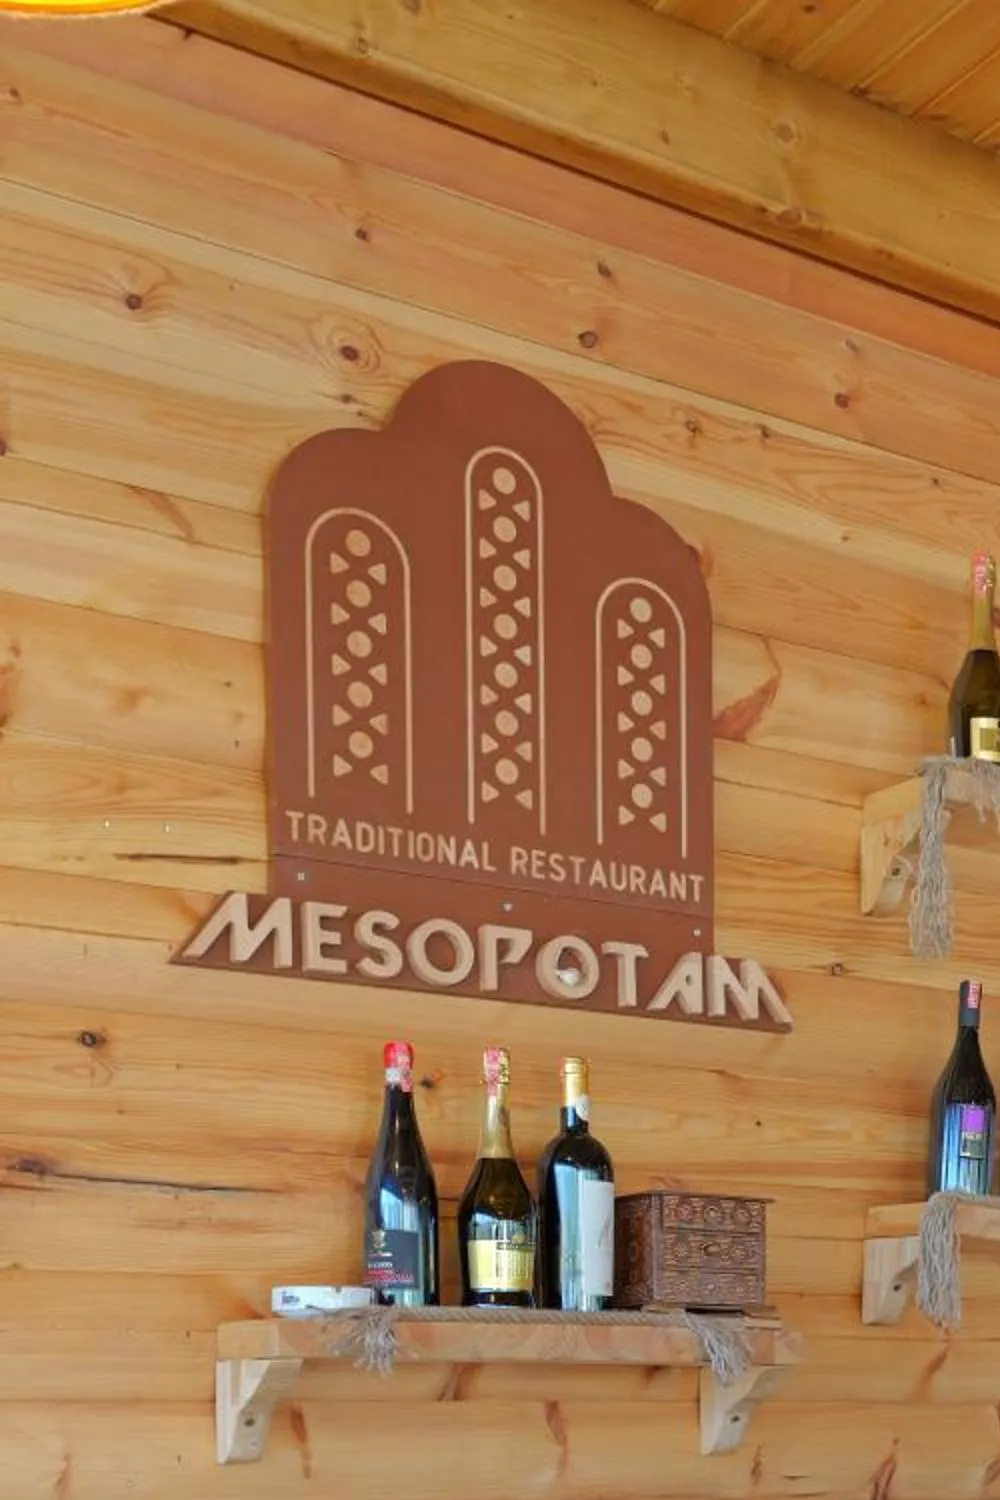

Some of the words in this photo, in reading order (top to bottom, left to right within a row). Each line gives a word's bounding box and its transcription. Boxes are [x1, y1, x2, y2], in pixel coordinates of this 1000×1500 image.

[284, 809, 498, 873] TRADITIONAL
[511, 849, 705, 902] RESTAURANT
[180, 890, 794, 1025] MESOPOTAM
